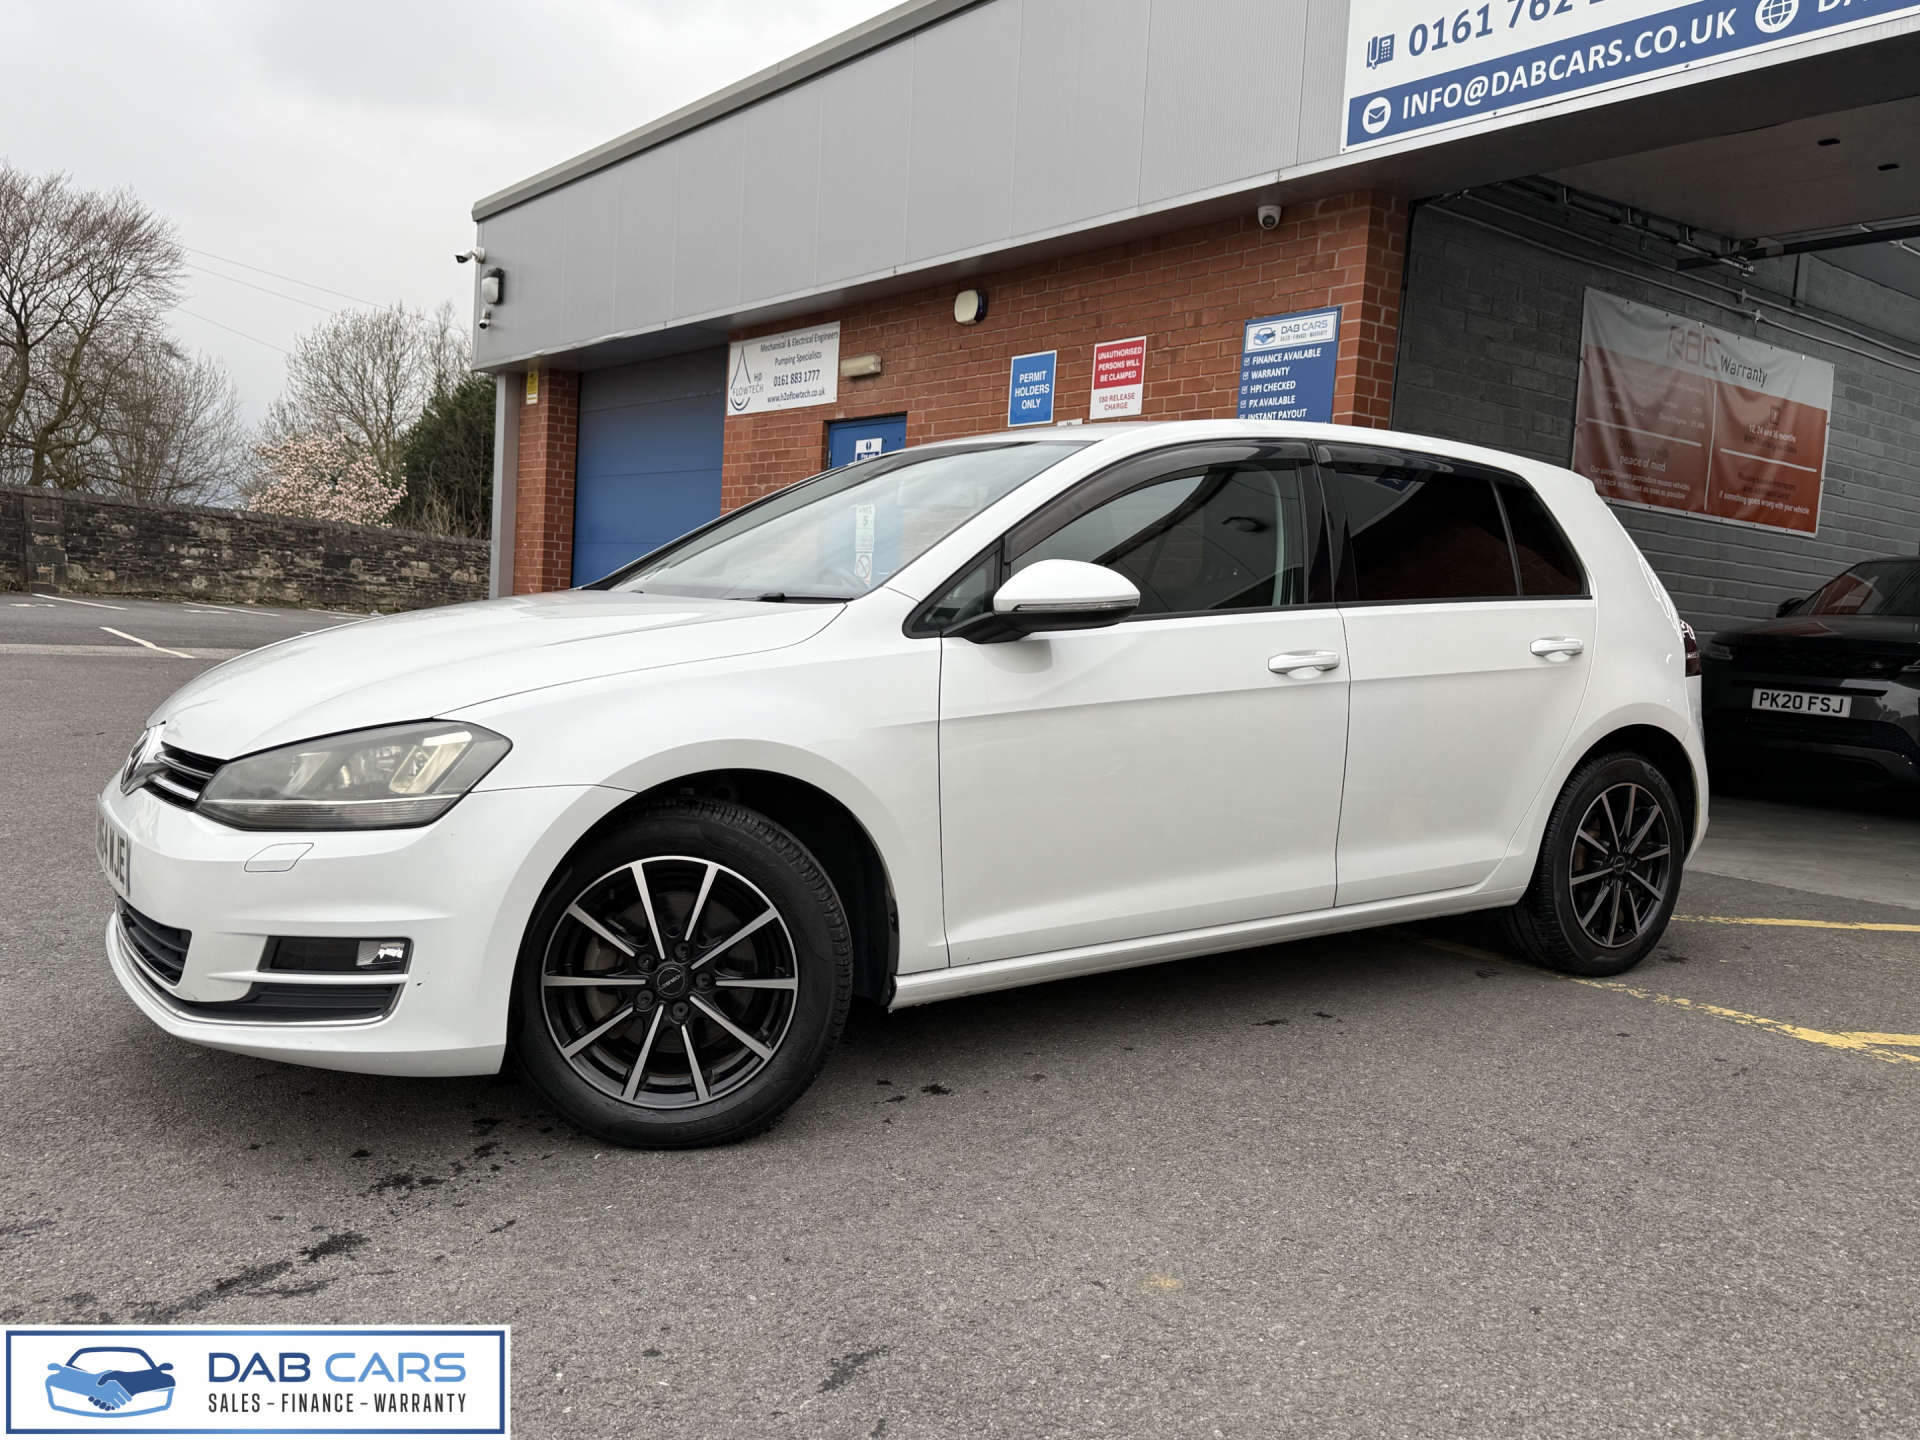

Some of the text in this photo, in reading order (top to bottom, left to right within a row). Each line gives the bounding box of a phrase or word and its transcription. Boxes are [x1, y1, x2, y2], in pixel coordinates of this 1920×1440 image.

[1408, 3, 1493, 56] 0161
[1402, 8, 1737, 119] INFO@DABCARS.CO.UK
[1281, 320, 1328, 335] DAB CARS
[814, 331, 839, 344] Engineers
[1097, 346, 1143, 360] UNAUTHORISED
[1252, 347, 1322, 365] FINANCE AVAILABLE
[1098, 358, 1140, 371] PERSONS WILL
[1720, 354, 1768, 388] Warranty
[773, 369, 820, 387] 0161 883 1777
[1019, 370, 1047, 384] PERMIT
[1099, 370, 1137, 382] BE CLAMPED
[1251, 366, 1290, 379] WARRANTY
[732, 384, 764, 397] FLOWTECH
[1014, 383, 1050, 398] HOLDERS
[1250, 380, 1296, 394] HPI CHECKED
[1021, 397, 1041, 410] ONLY
[1109, 392, 1135, 402] RELEASE
[1248, 395, 1297, 408] PX AVAILABLE
[1104, 402, 1128, 411] CHARGE
[1247, 410, 1278, 421] INSTANT
[1277, 407, 1308, 420] PAYOUT
[1759, 691, 1844, 714] PK20 FSJ
